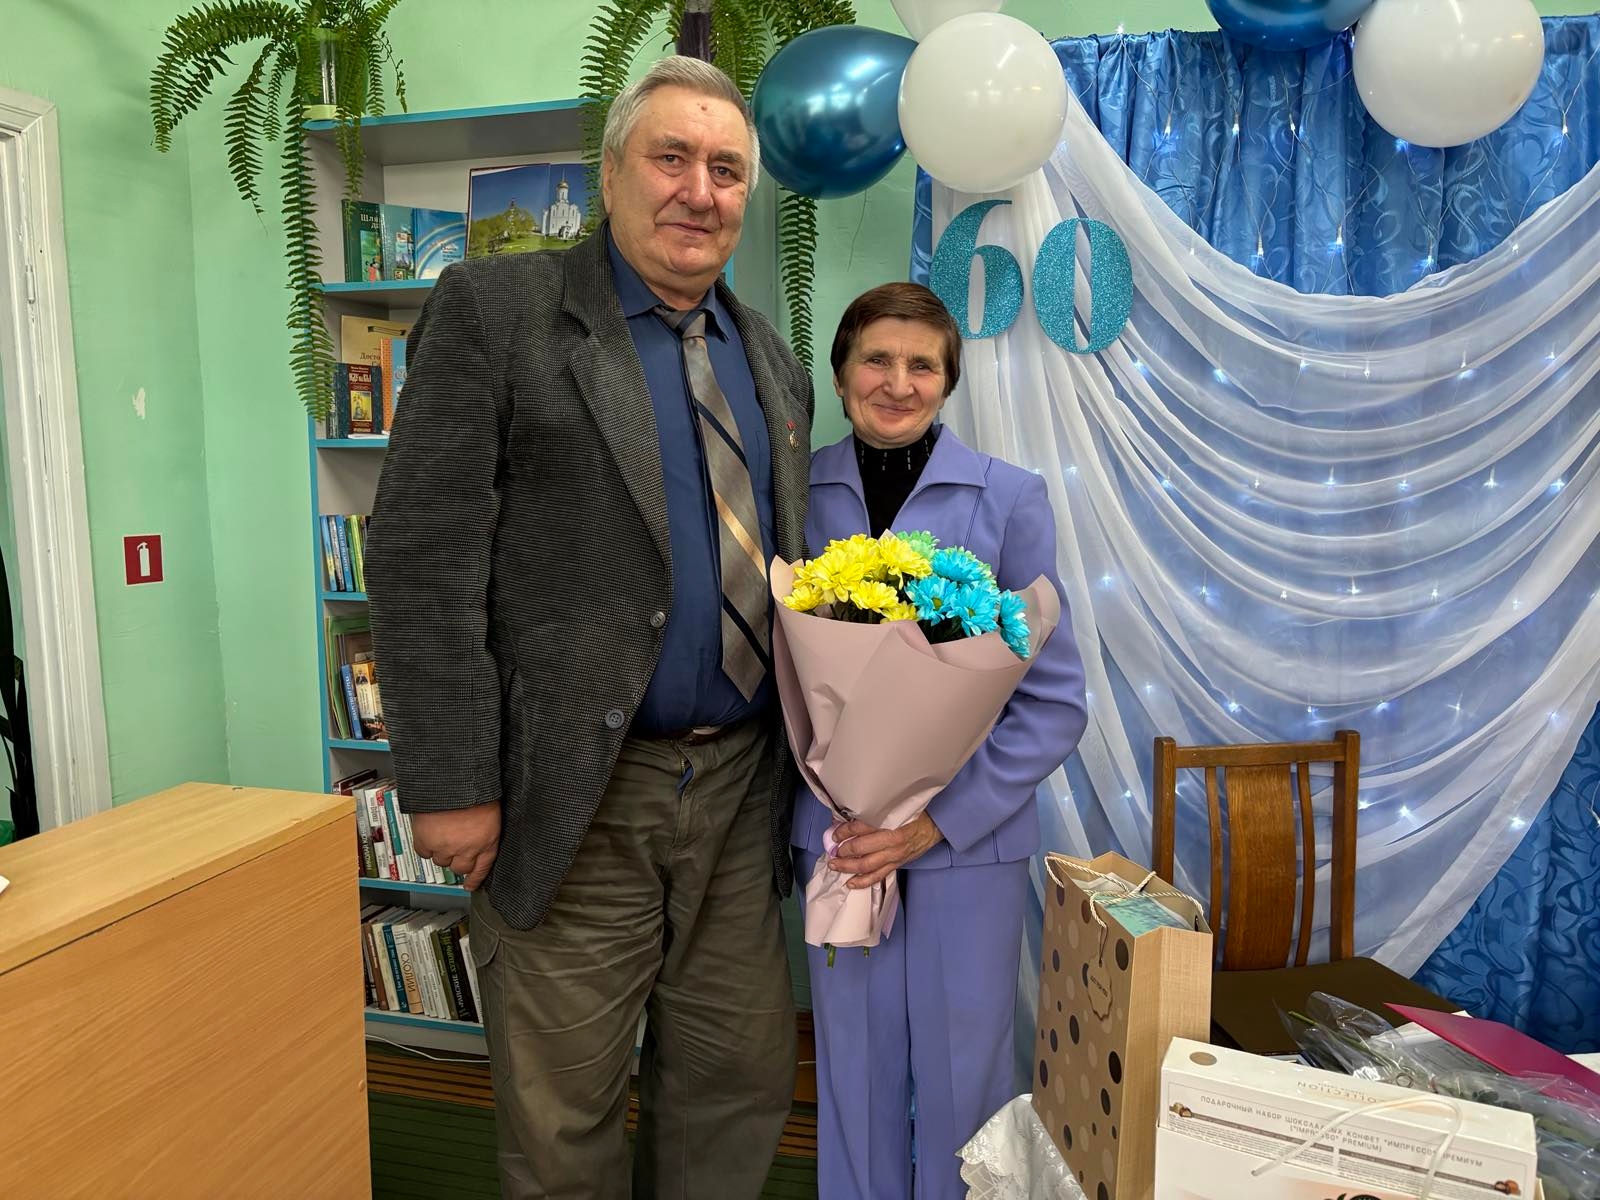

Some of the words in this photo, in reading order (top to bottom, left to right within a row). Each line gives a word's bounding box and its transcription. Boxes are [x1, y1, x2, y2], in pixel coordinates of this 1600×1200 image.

[929, 200, 1133, 354] 60
[401, 953, 415, 992] СХОЛИИ
[1298, 1081, 1378, 1103] OLLECTION
[1200, 1095, 1253, 1113] ПОДАРОЧНЫЙ
[1256, 1109, 1282, 1120] НАБОР
[1285, 1116, 1343, 1136] ШОКОЛАЫХ
[1346, 1131, 1380, 1144] КОНФЕТ
[1343, 1136, 1382, 1153] PREMIUM)
